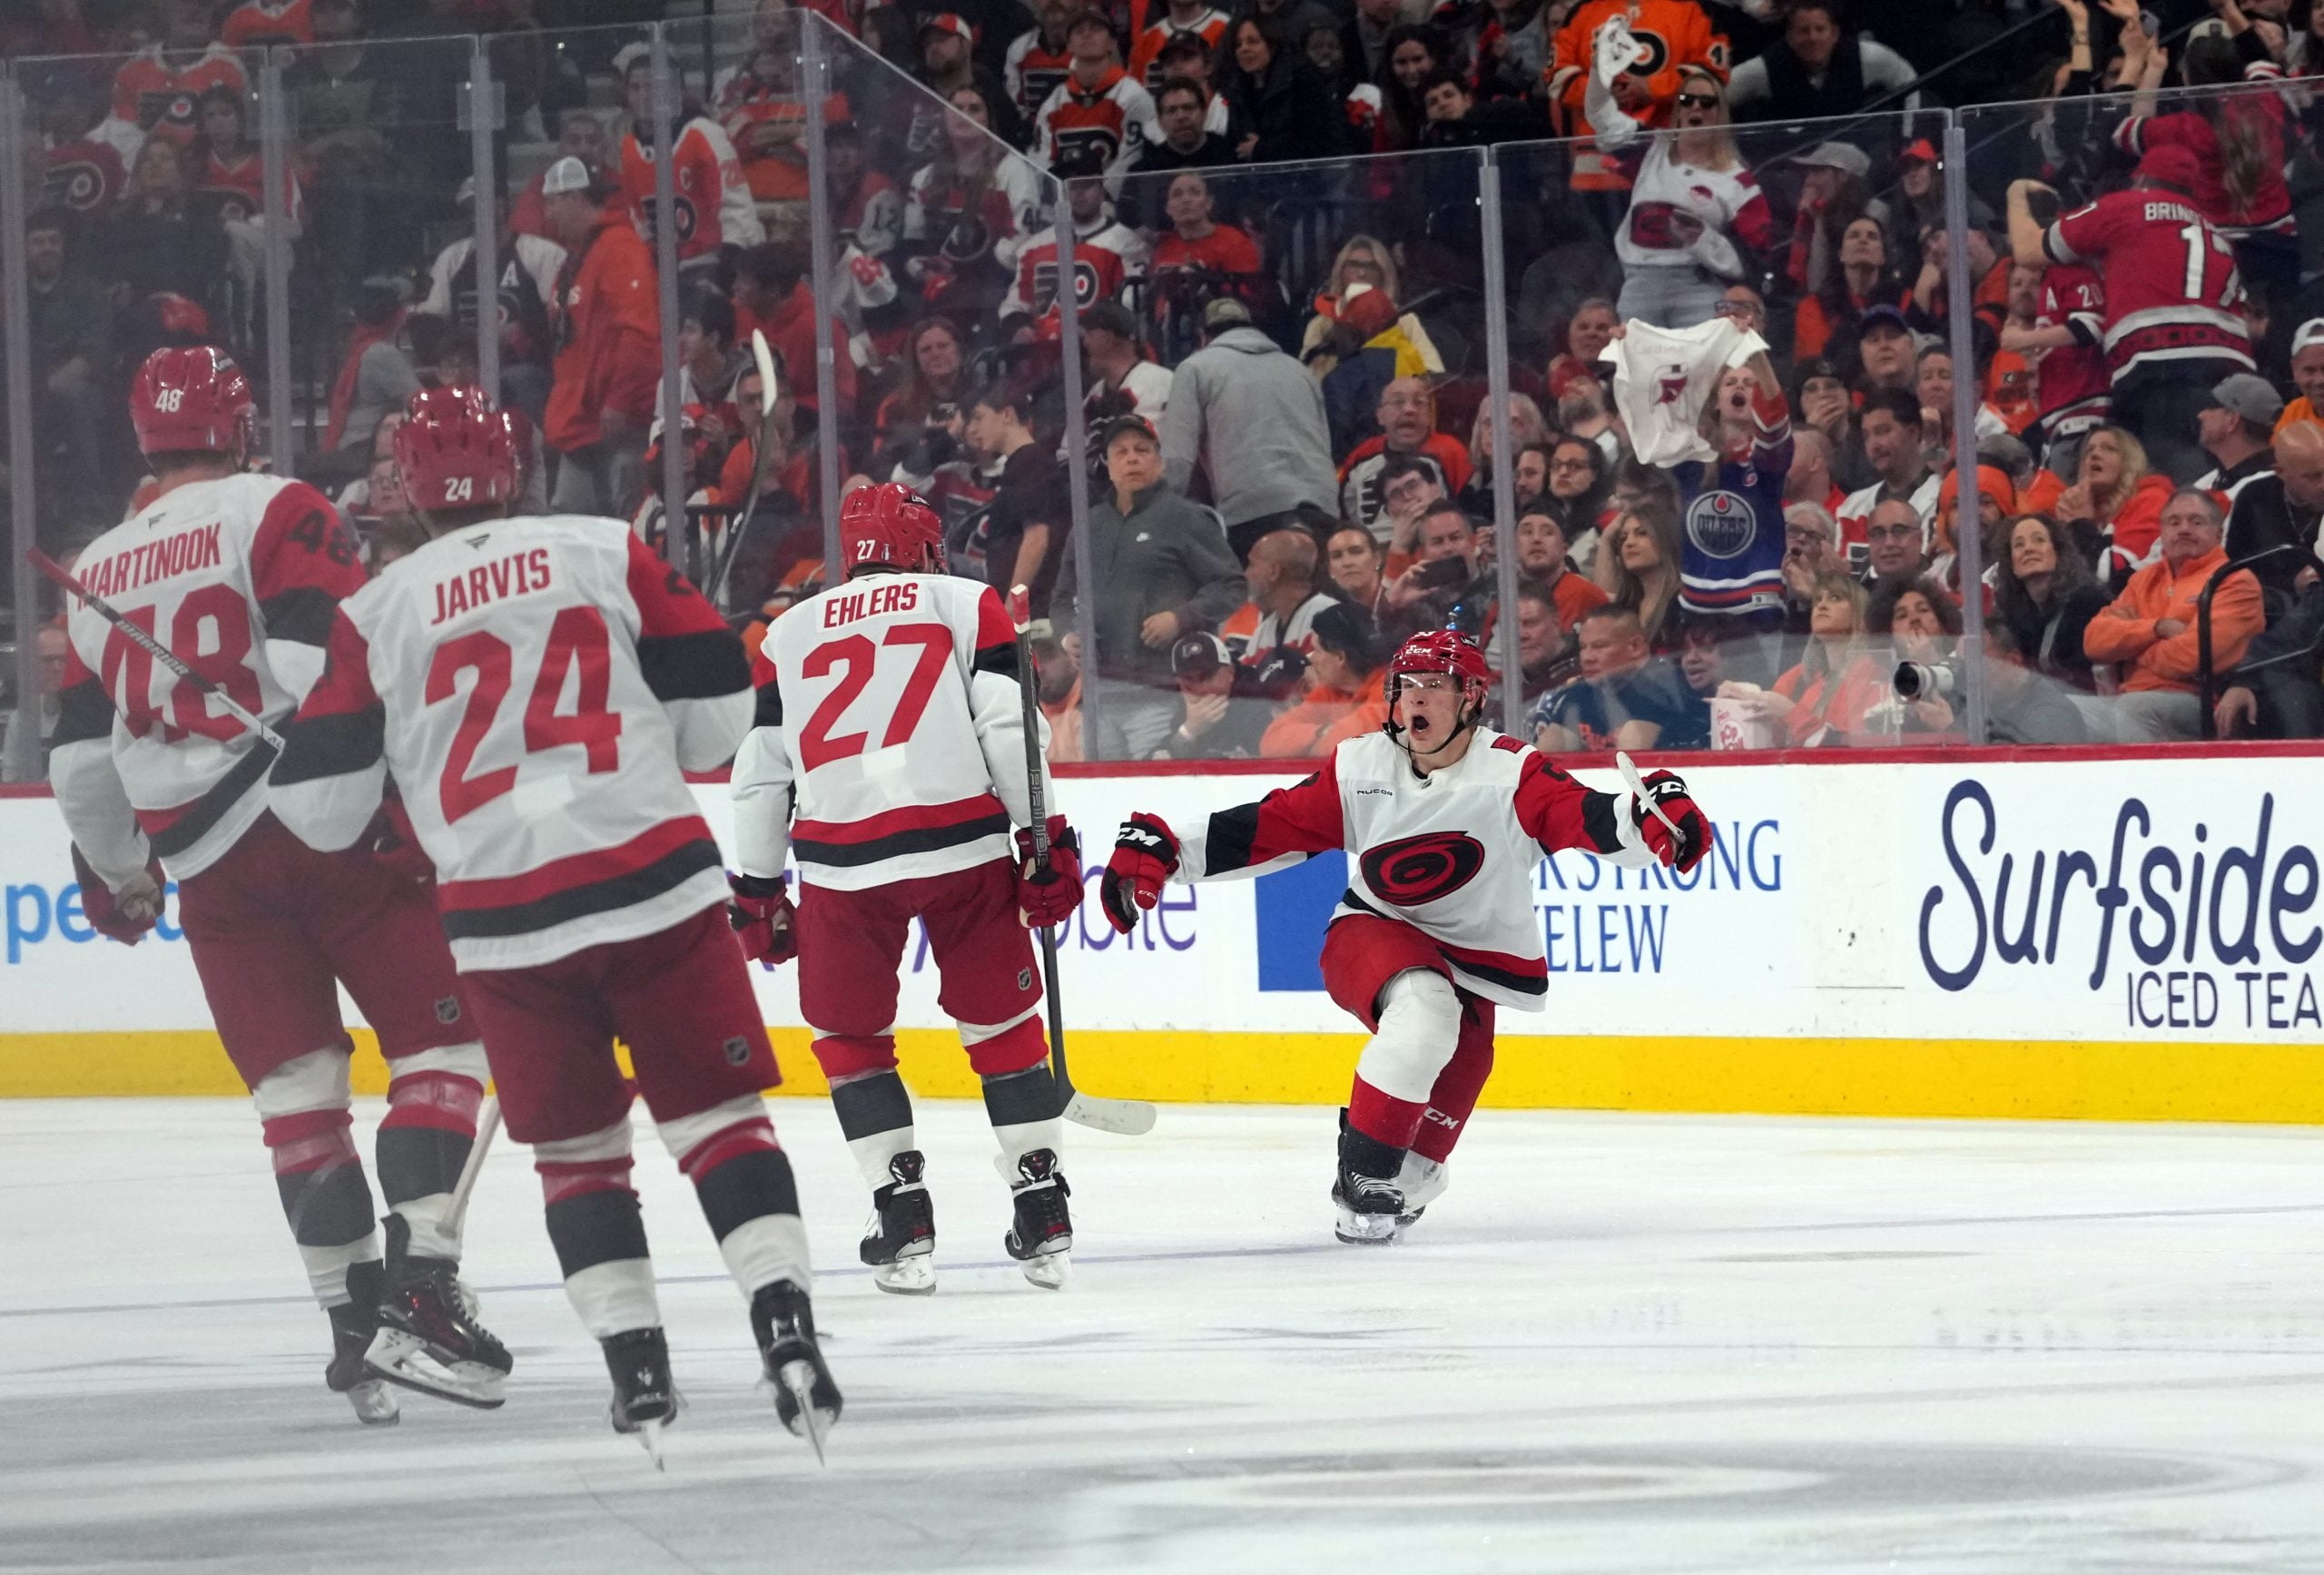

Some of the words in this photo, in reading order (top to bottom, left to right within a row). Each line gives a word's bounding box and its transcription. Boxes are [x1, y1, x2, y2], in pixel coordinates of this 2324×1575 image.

[500, 260, 520, 287] A
[154, 389, 183, 413] 48
[444, 476, 473, 502] 24
[77, 522, 222, 611] MARTINOOK
[287, 508, 360, 567] 48
[857, 539, 876, 561] 27
[430, 547, 551, 625] JARVIS
[823, 582, 919, 628] EHLERS
[101, 582, 264, 743] 48
[425, 605, 623, 825] 24
[799, 623, 952, 773] 27
[1356, 788, 1393, 797] NUCOR
[1918, 778, 2323, 992] Surfside
[1534, 904, 1669, 974] ELEW
[2128, 970, 2219, 1029] ICED
[2234, 971, 2323, 1029] TEA
[1423, 1105, 1459, 1130] CM
